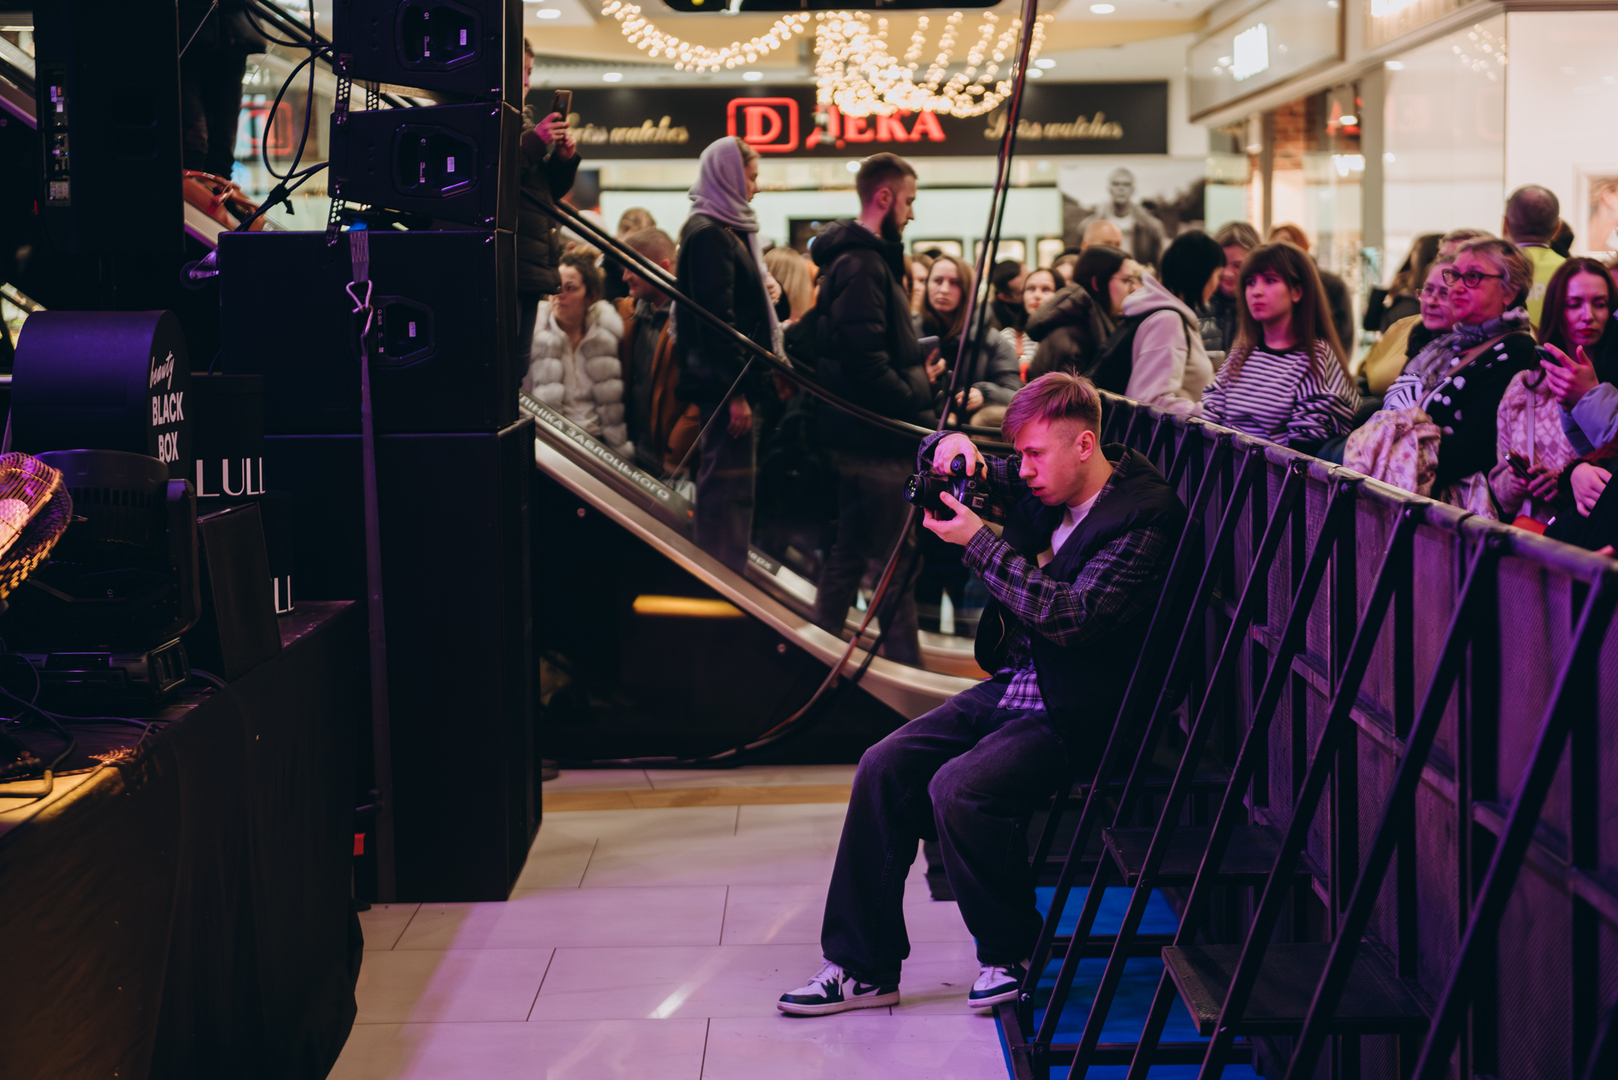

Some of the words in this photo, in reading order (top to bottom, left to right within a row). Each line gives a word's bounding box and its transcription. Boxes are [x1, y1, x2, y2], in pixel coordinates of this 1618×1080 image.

[743, 105, 783, 144] D
[149, 350, 175, 390] beauty
[152, 391, 184, 427] BLACK
[158, 431, 179, 463] BOX
[519, 392, 564, 431] ЛІНІКА
[566, 427, 670, 502] ЗАБЛОЦЬКОГО
